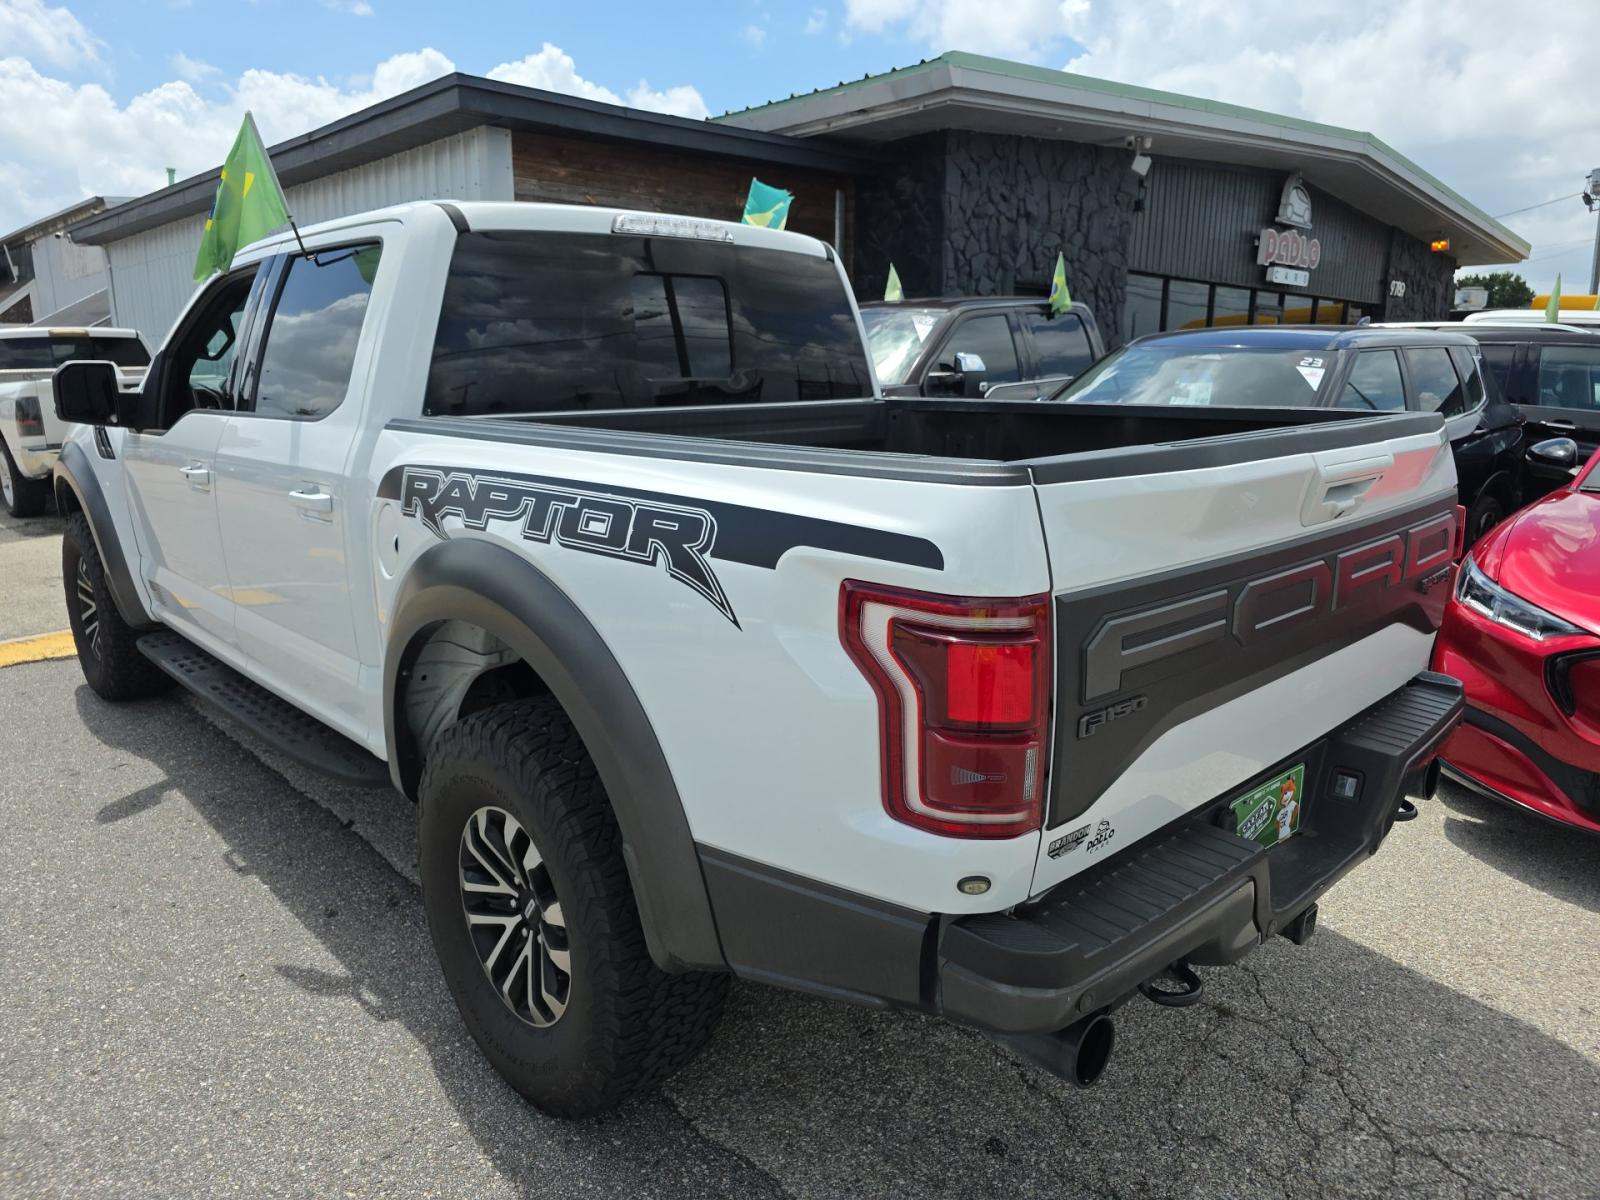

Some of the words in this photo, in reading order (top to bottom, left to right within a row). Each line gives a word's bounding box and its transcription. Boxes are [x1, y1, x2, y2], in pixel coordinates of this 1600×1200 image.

[401, 466, 743, 632] RAPTOR
[1083, 510, 1457, 702] FORD
[1049, 824, 1092, 853] BRANDON
